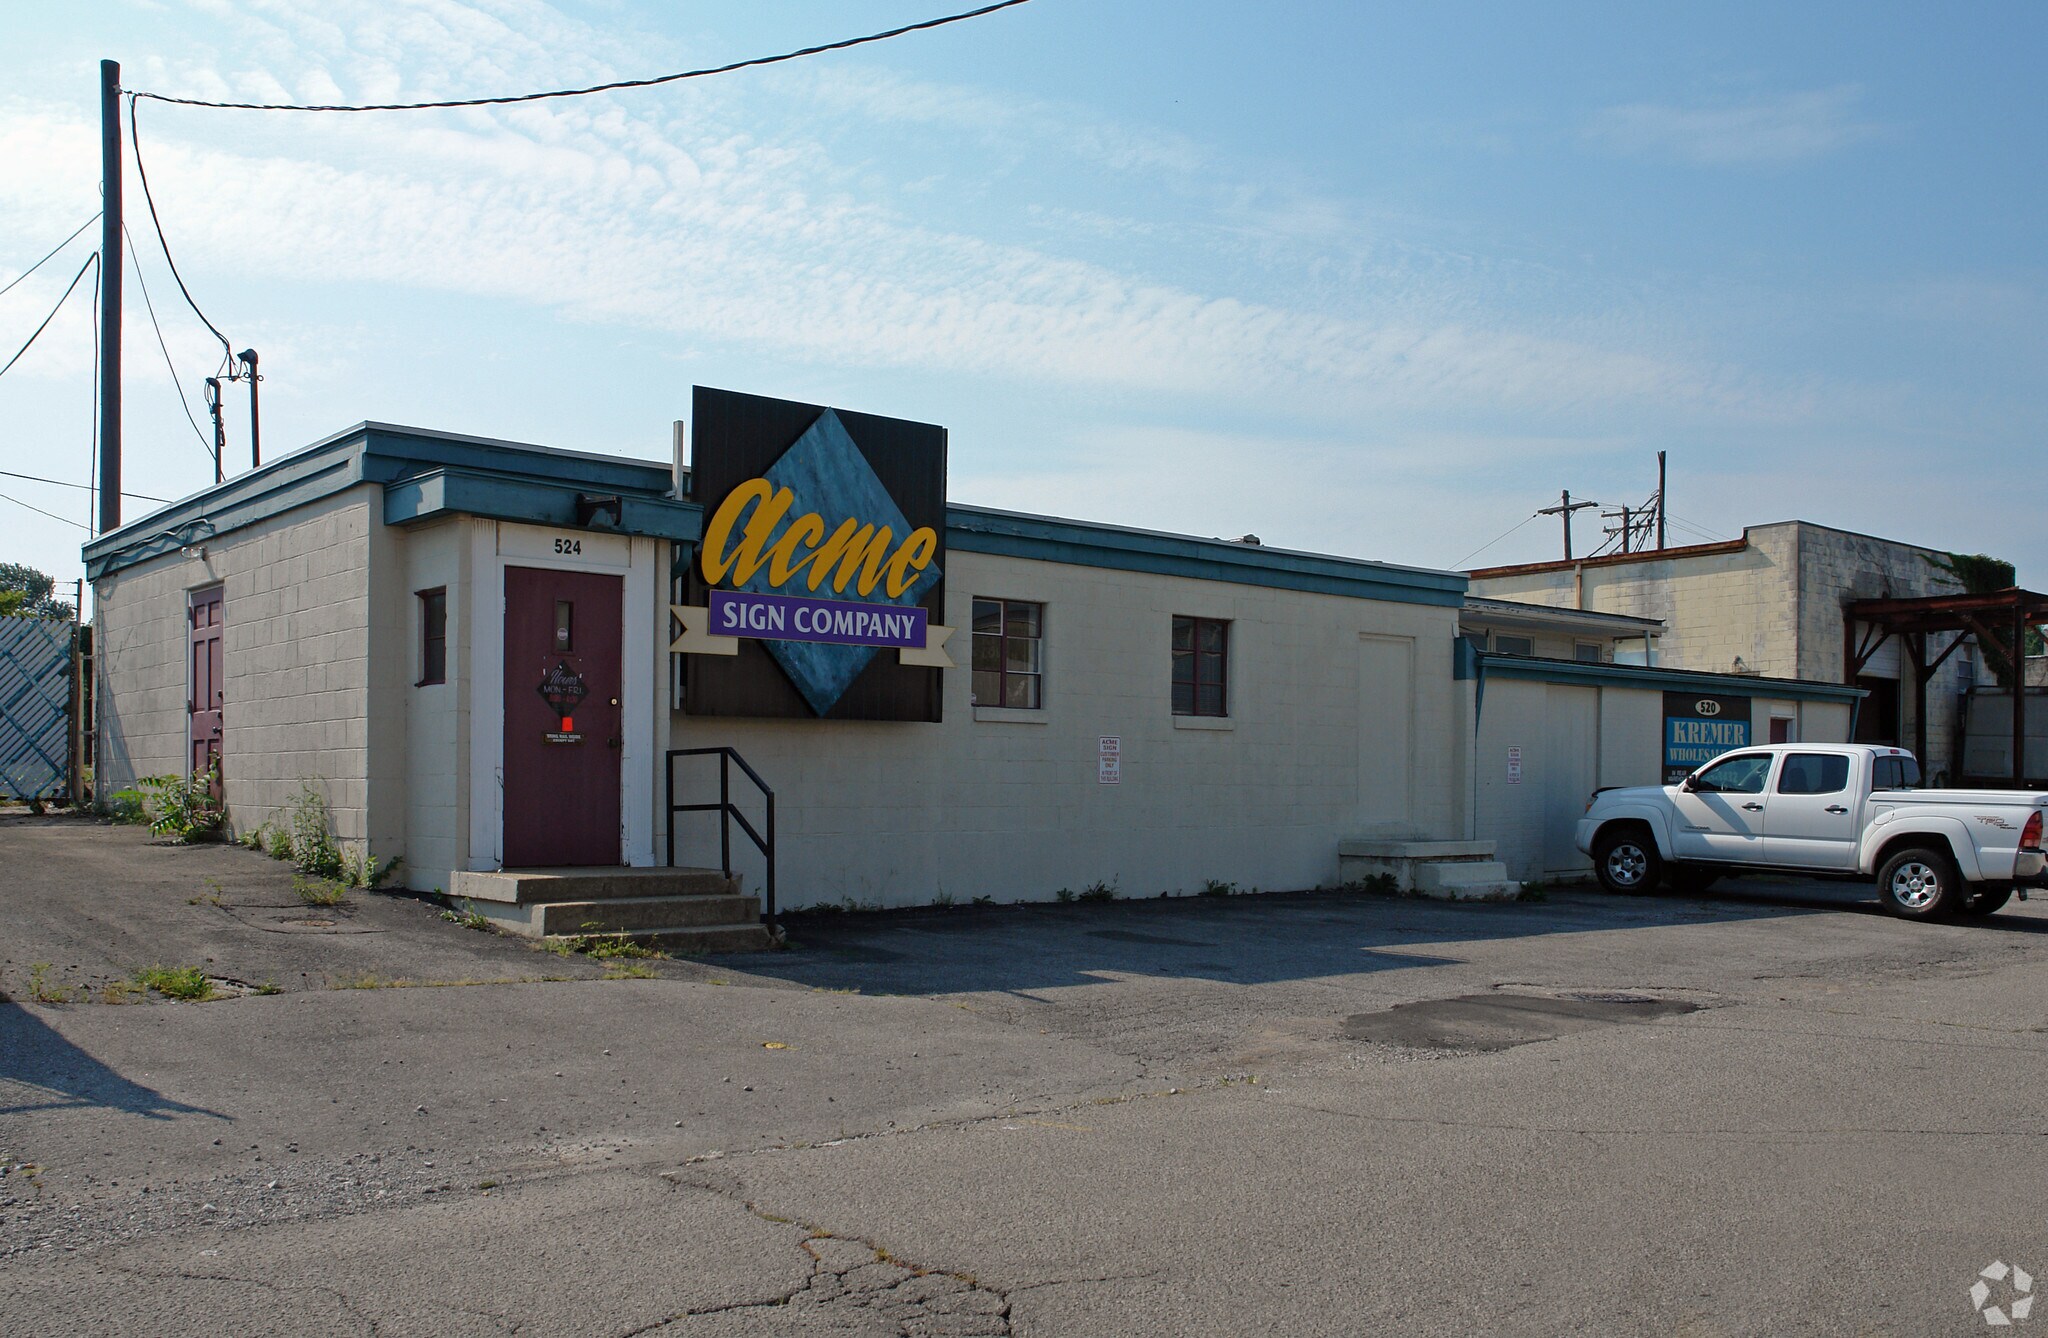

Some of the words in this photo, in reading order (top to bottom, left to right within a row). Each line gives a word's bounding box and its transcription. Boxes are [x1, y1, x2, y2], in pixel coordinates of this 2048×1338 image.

[554, 538, 582, 555] 524
[722, 601, 786, 632] SIGN
[793, 606, 916, 640] COMPANY
[550, 670, 578, 685] Hours
[1700, 701, 1716, 713] 520
[1672, 721, 1745, 746] KREMER
